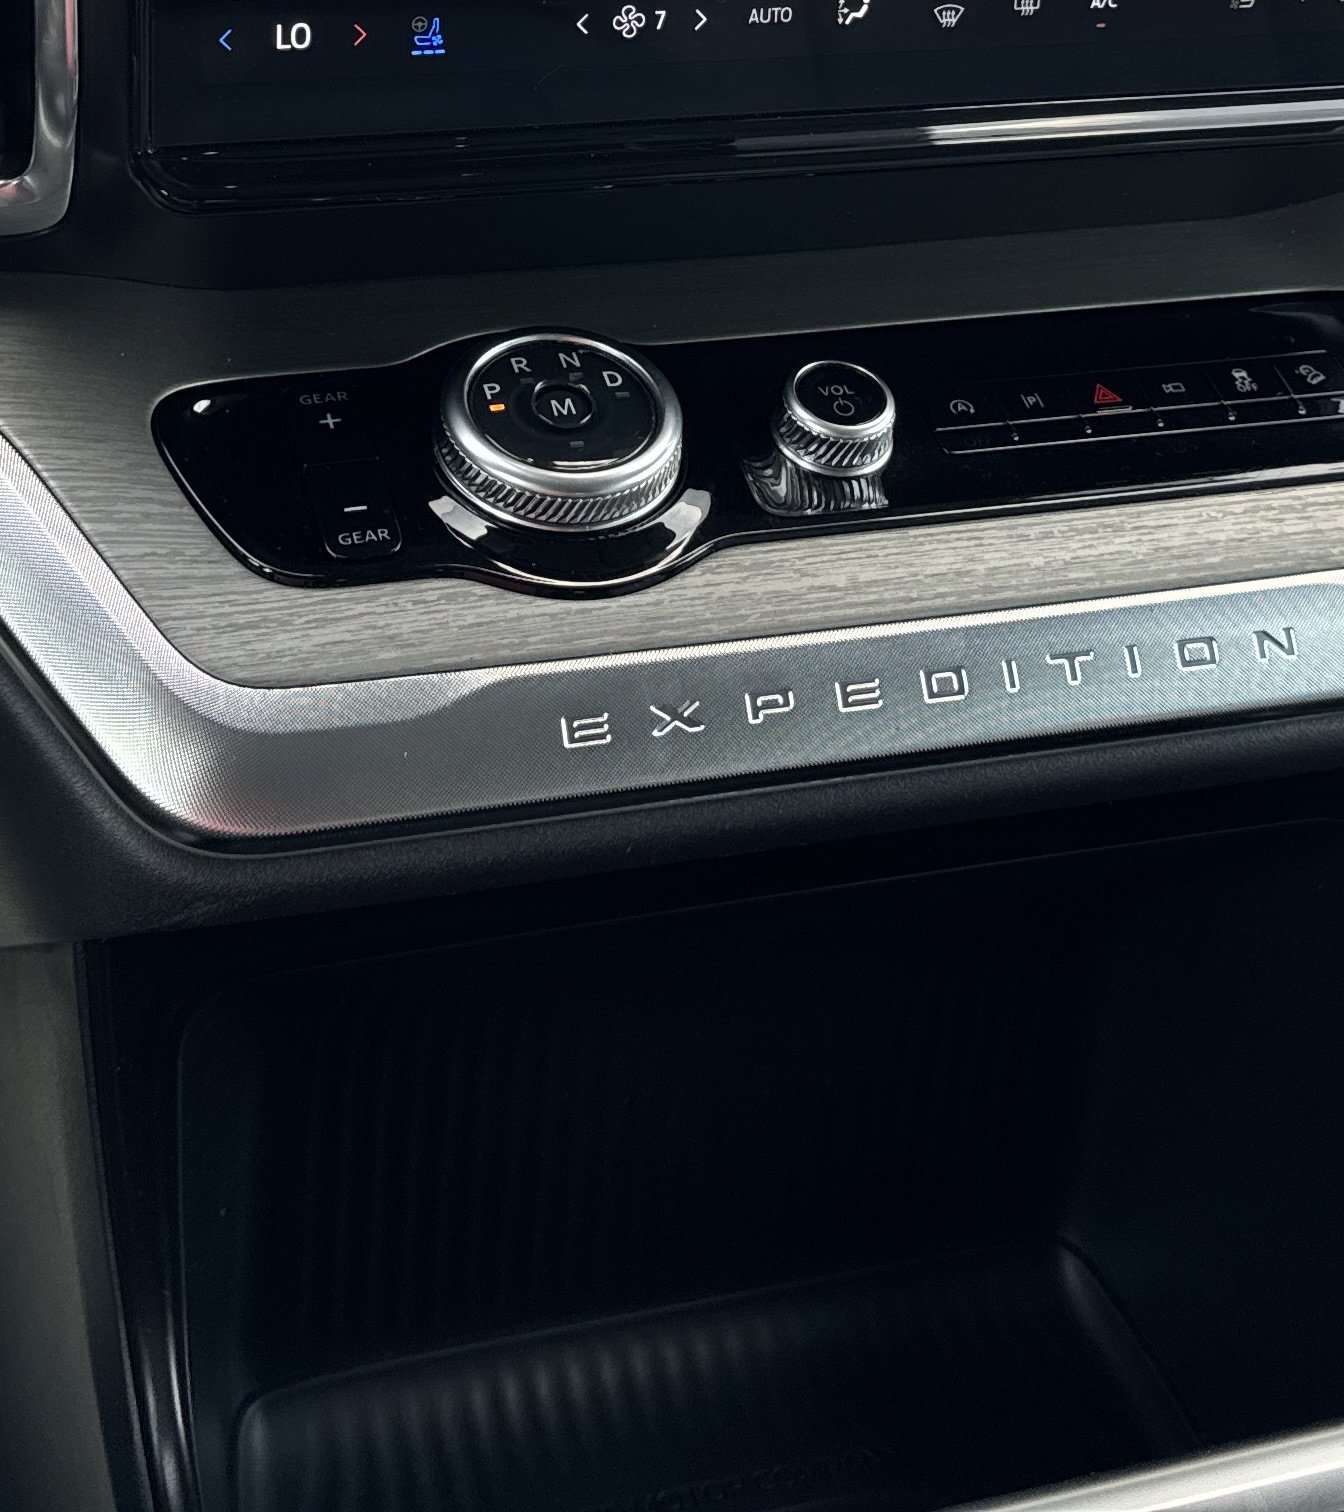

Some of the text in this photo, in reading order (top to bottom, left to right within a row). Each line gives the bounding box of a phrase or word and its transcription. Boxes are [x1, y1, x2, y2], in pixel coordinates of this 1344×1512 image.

[654, 10, 667, 30] 7
[748, 6, 793, 25] AUTO
[276, 22, 311, 50] LO
[511, 356, 531, 375] R
[559, 351, 581, 370] N
[603, 369, 623, 389] D
[300, 391, 349, 405] GEAR
[483, 382, 501, 401] P
[818, 384, 856, 399] VOL
[550, 397, 576, 418] M
[337, 526, 391, 546] GEAR
[560, 626, 1299, 749] EXPEDITION
